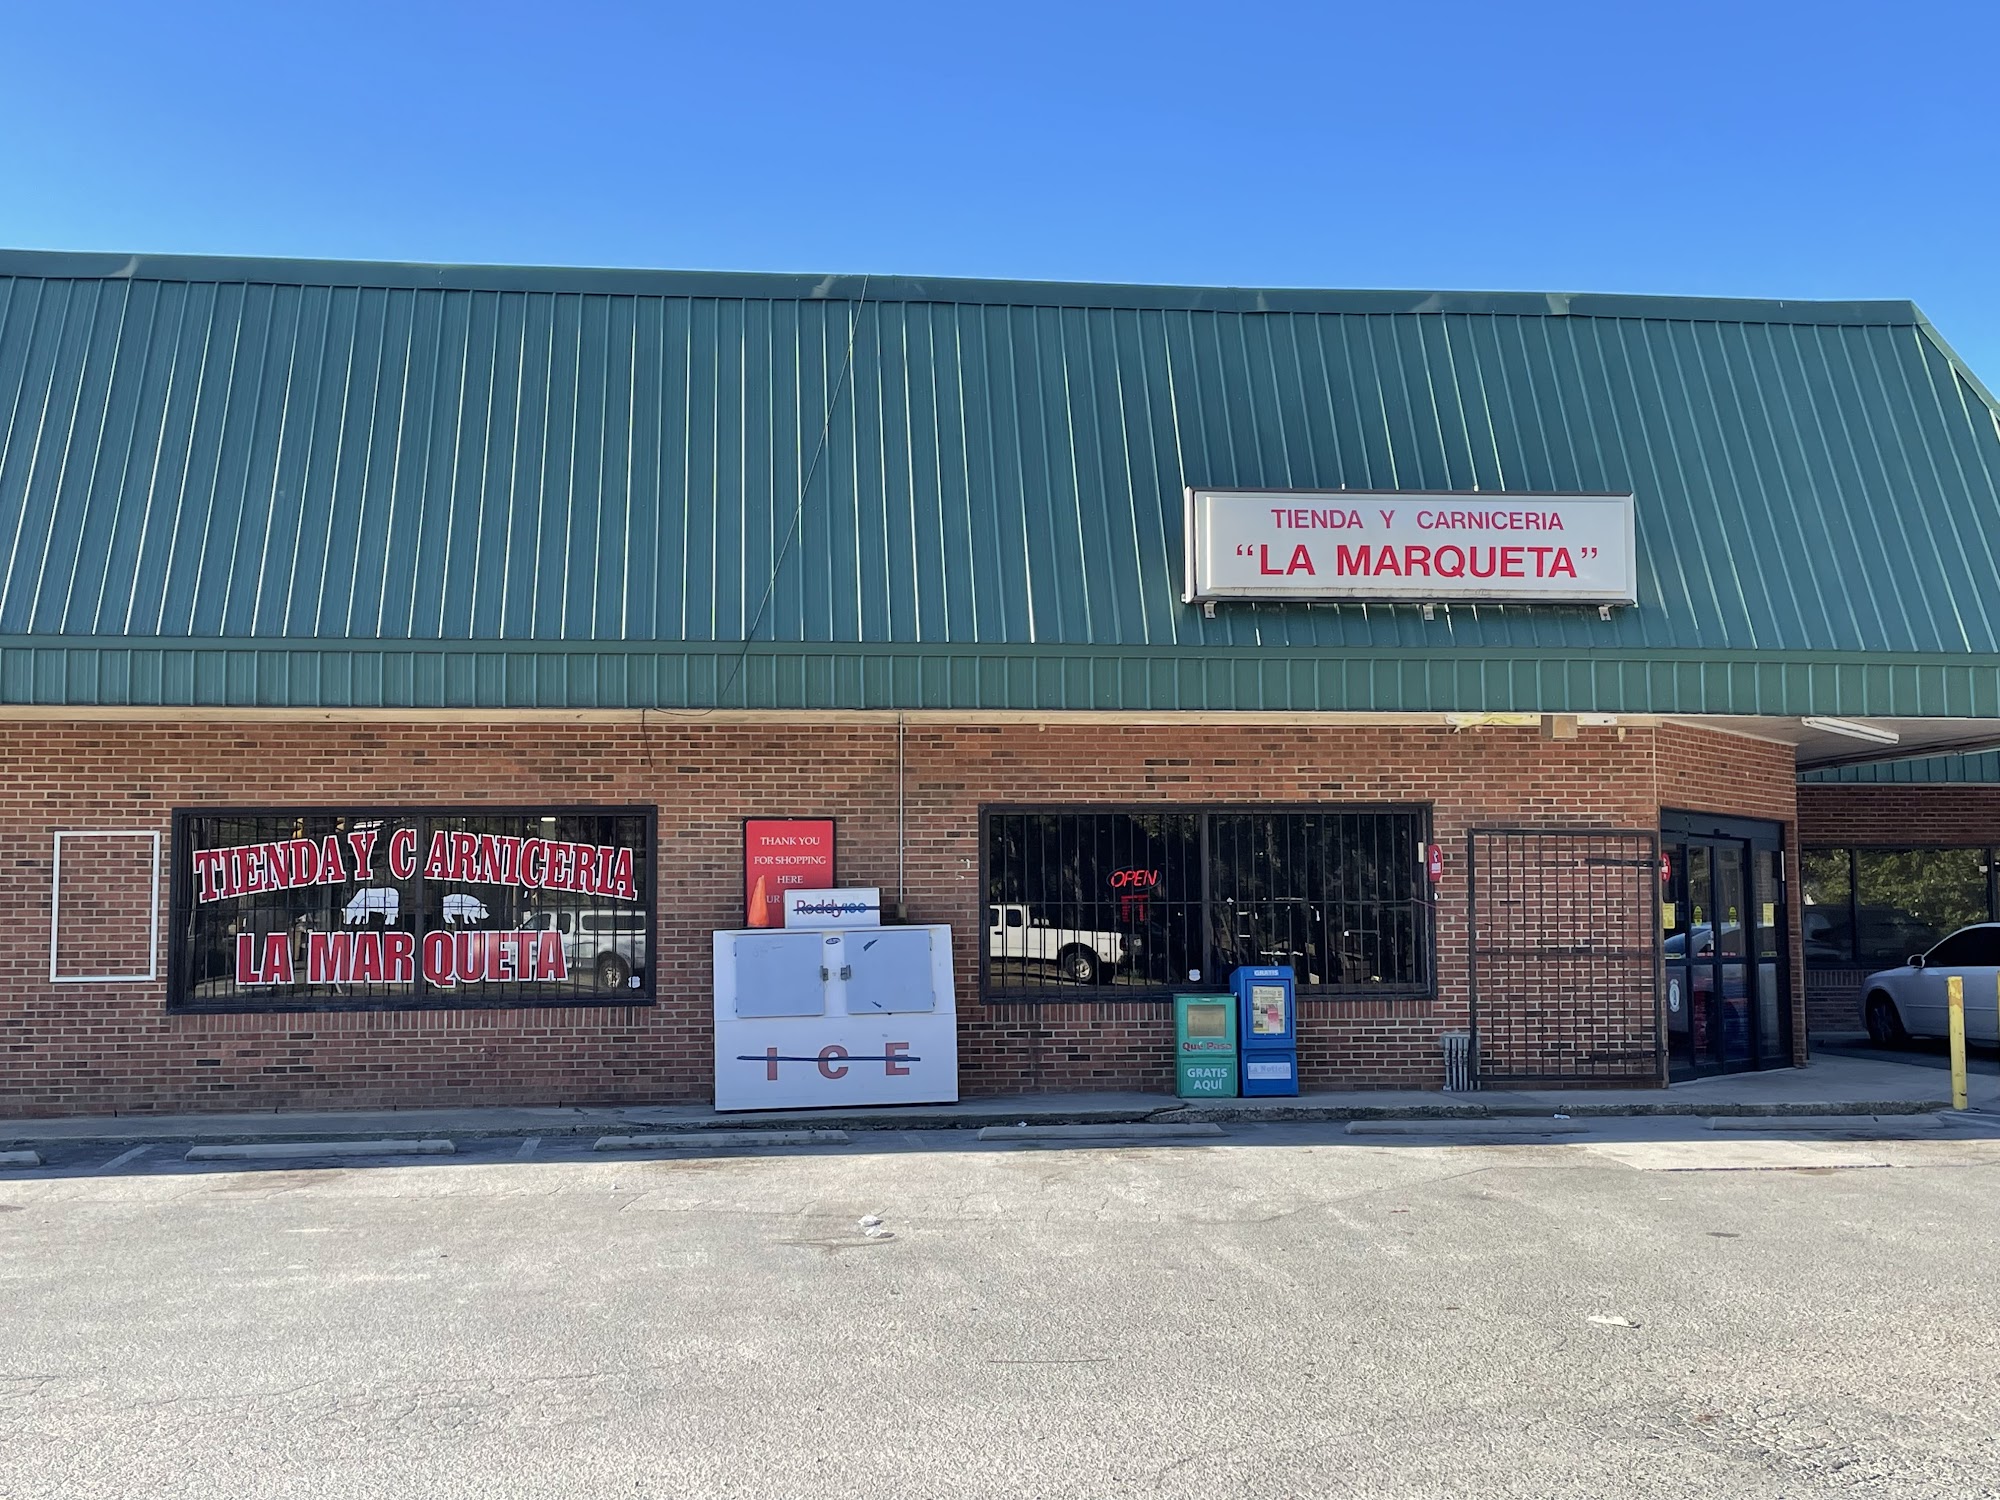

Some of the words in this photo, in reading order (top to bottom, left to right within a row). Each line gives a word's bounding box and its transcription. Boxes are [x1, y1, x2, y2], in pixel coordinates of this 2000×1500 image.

[1270, 509, 1364, 529] TIENDA
[1379, 510, 1395, 529] Y
[1416, 510, 1564, 531] CARNICERIA
[760, 837, 796, 846] THANK
[798, 837, 820, 846] YOU
[754, 856, 774, 865] FOR
[775, 856, 827, 865] SHOPPING
[193, 832, 347, 903] TIENDA
[348, 831, 381, 881] Y
[777, 875, 804, 884] HERE
[1110, 869, 1158, 887] OPEN
[766, 895, 780, 904] UR
[235, 931, 294, 986] LA
[1206, 1042, 1232, 1050] Pasa
[766, 1042, 910, 1081] ICE
[1187, 1068, 1228, 1078] GRATIS
[1193, 1079, 1222, 1091] AQUÍ
